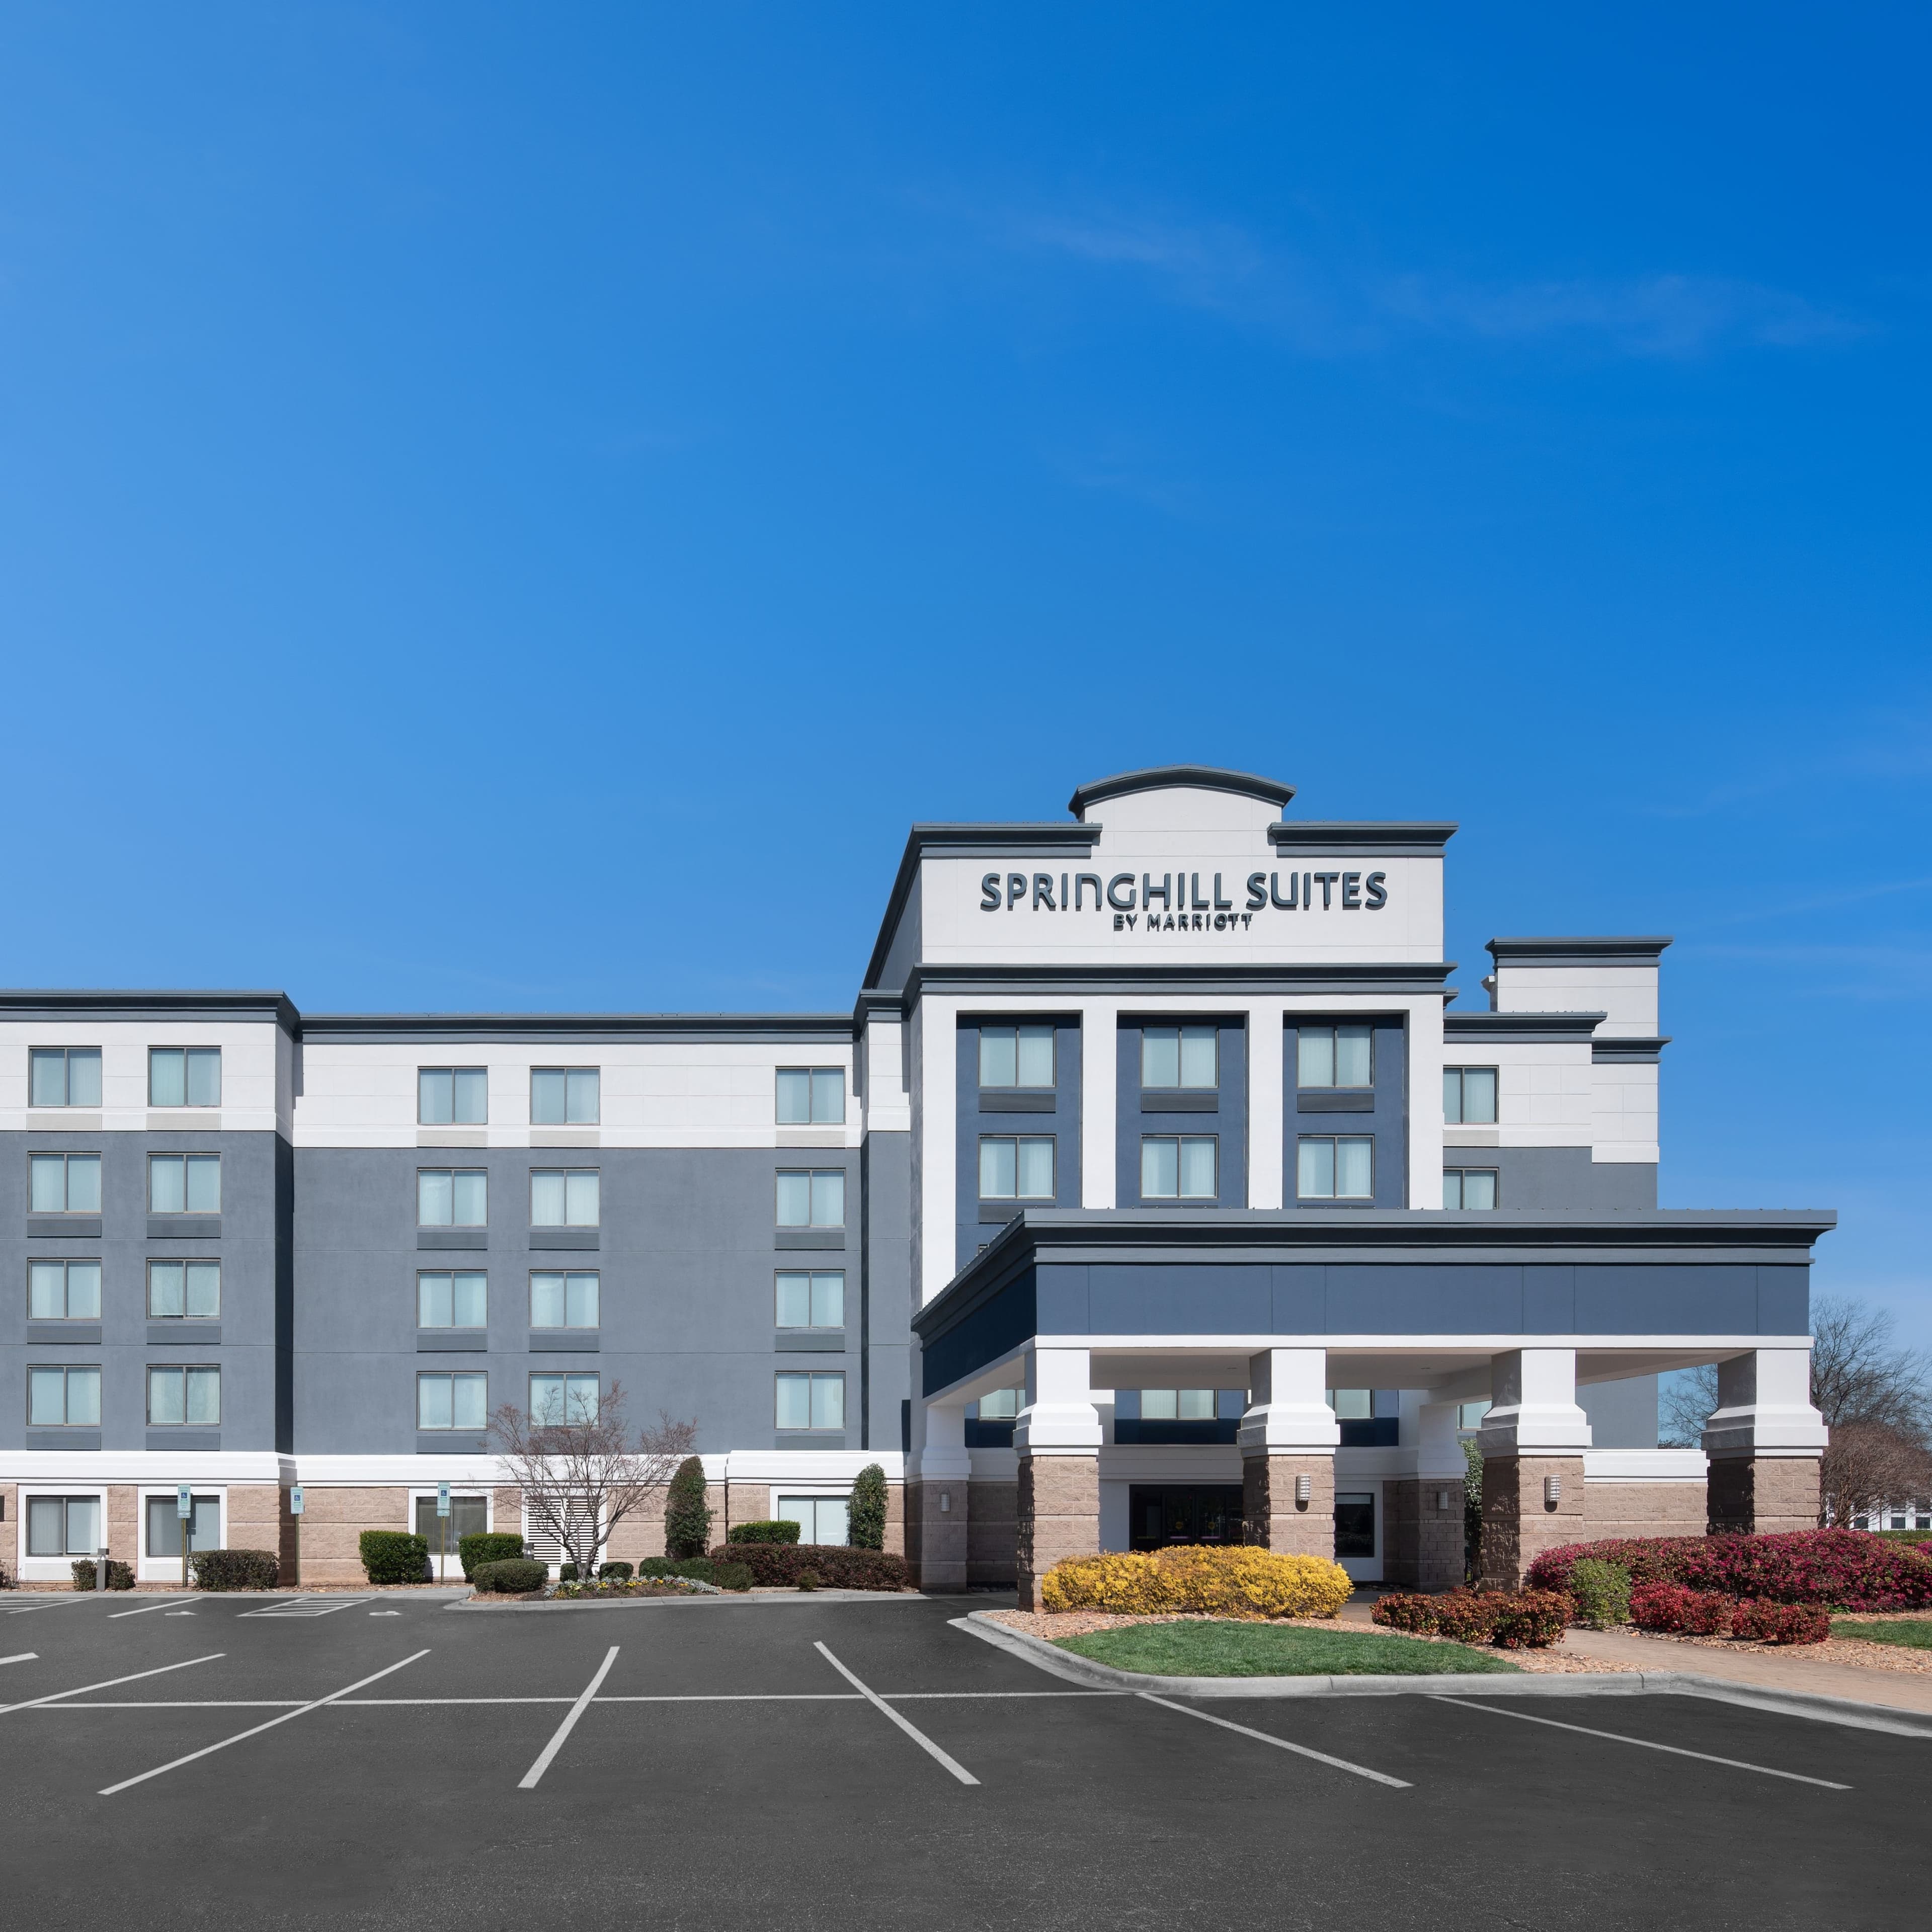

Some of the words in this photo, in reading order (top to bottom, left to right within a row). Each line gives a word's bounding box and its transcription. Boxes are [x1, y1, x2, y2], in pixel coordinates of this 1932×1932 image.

[981, 872, 1233, 908] SPRINGHILL
[1246, 871, 1388, 908] SUITES
[1113, 914, 1138, 929] BY
[1147, 913, 1253, 929] MARRIOTT
